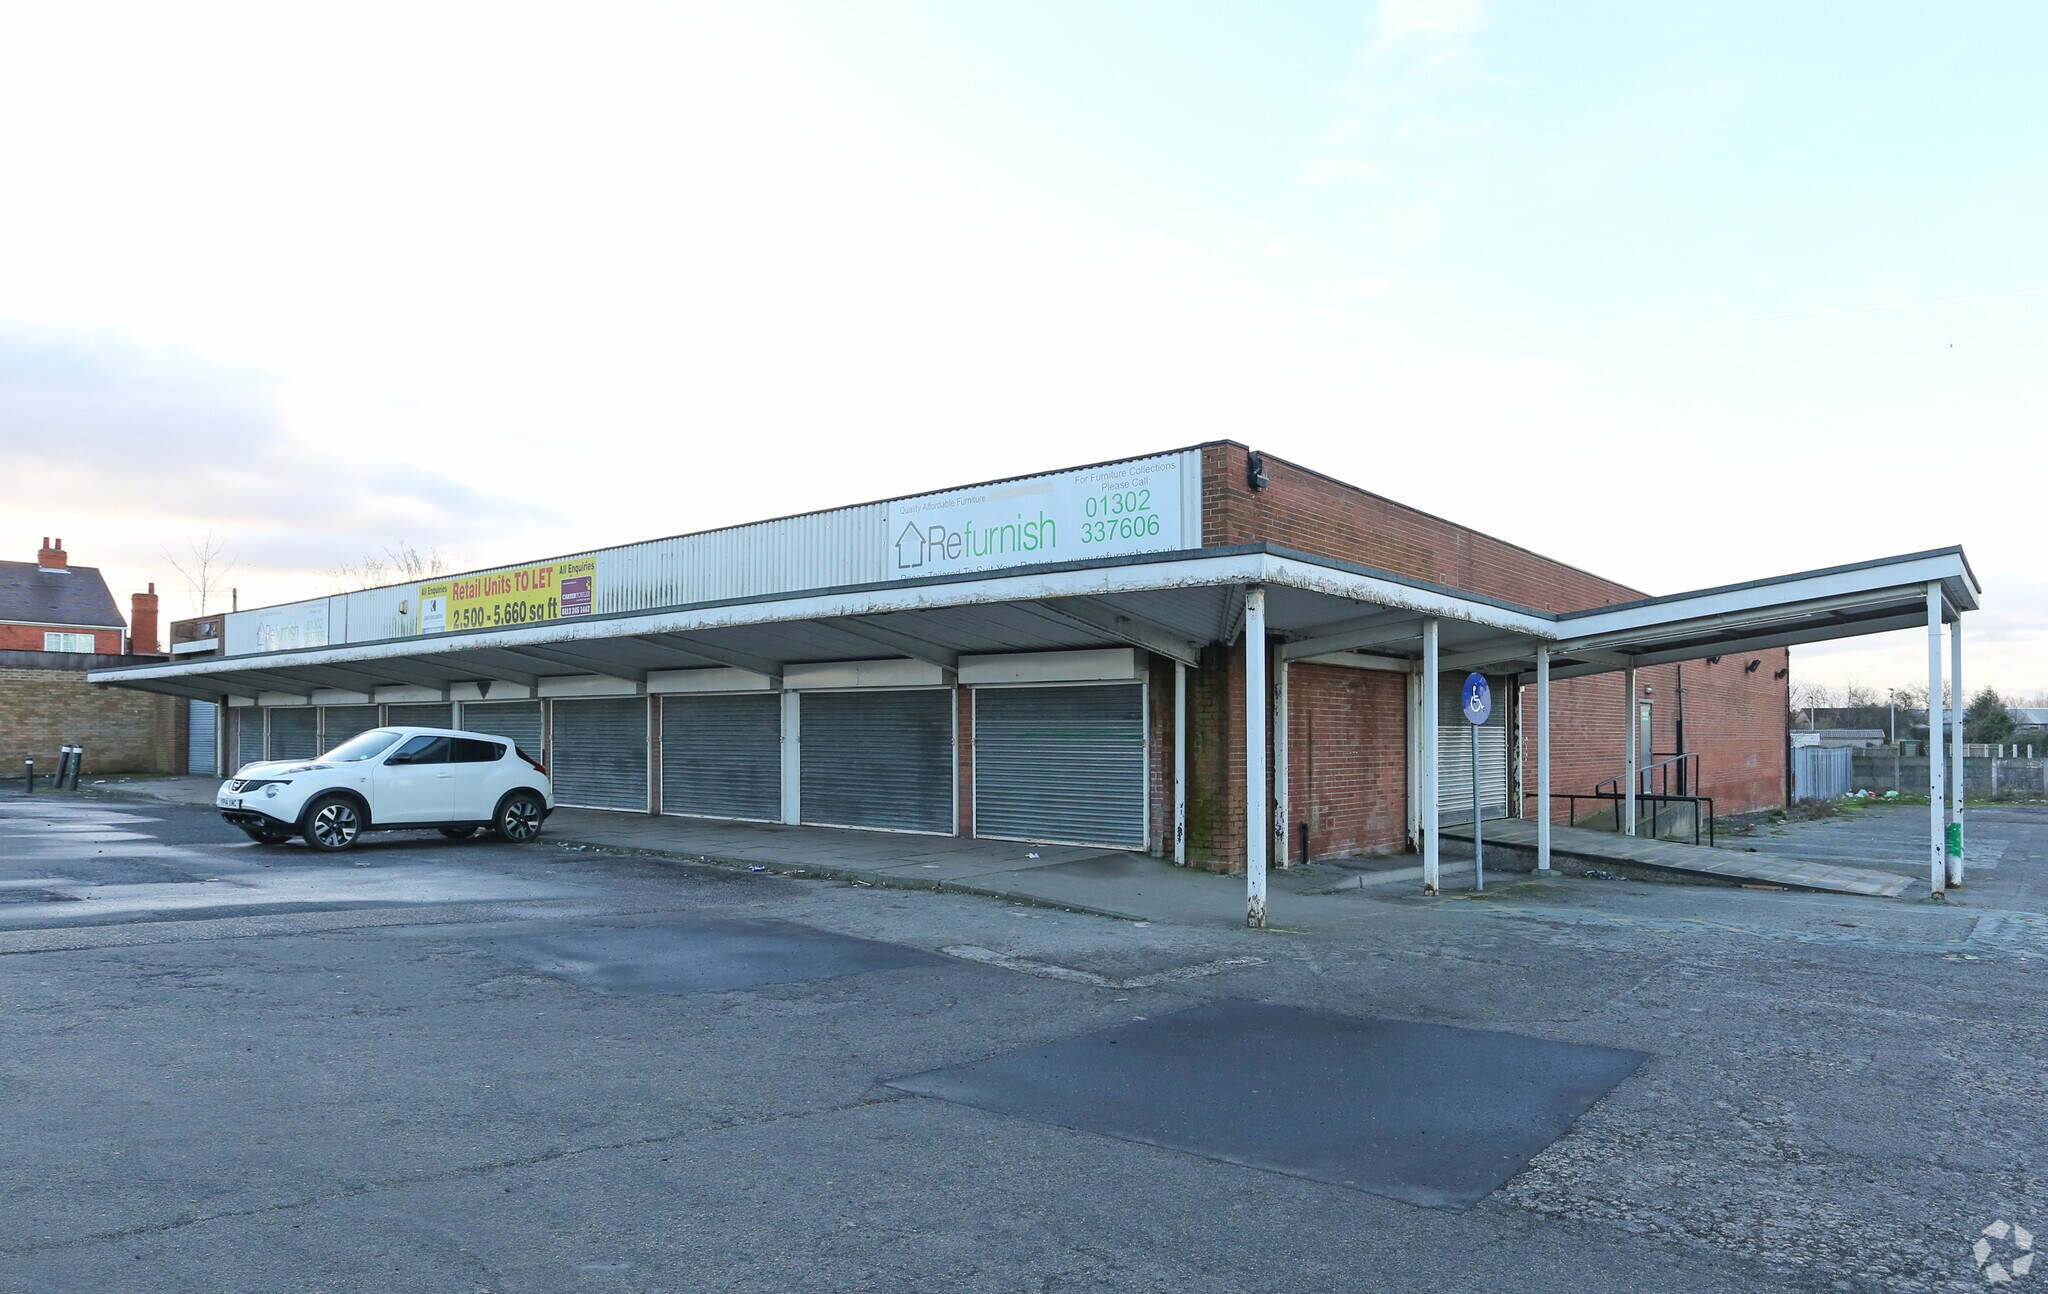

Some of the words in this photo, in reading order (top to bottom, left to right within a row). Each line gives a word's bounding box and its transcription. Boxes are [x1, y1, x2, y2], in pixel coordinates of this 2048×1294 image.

[1075, 475, 1088, 485] For
[1091, 470, 1126, 483] Furniture
[1129, 462, 1176, 476] Collections
[1101, 481, 1129, 491] Please
[1132, 477, 1151, 487] Call:
[900, 504, 921, 515] Quality
[922, 500, 954, 512] Affordable
[957, 495, 987, 506] Furniture
[1085, 489, 1151, 518] 01302
[928, 510, 1056, 562] Refurnish
[1081, 514, 1160, 544] 337606
[568, 561, 595, 575] Enquiries
[428, 585, 448, 596] Enquiries
[453, 579, 481, 601] Retail
[484, 575, 511, 597] Units
[514, 570, 529, 591] TO
[532, 566, 553, 589] LET
[453, 606, 484, 629] 2,500
[494, 601, 527, 626] 5,660
[529, 603, 544, 621] sq
[547, 597, 557, 619] ft
